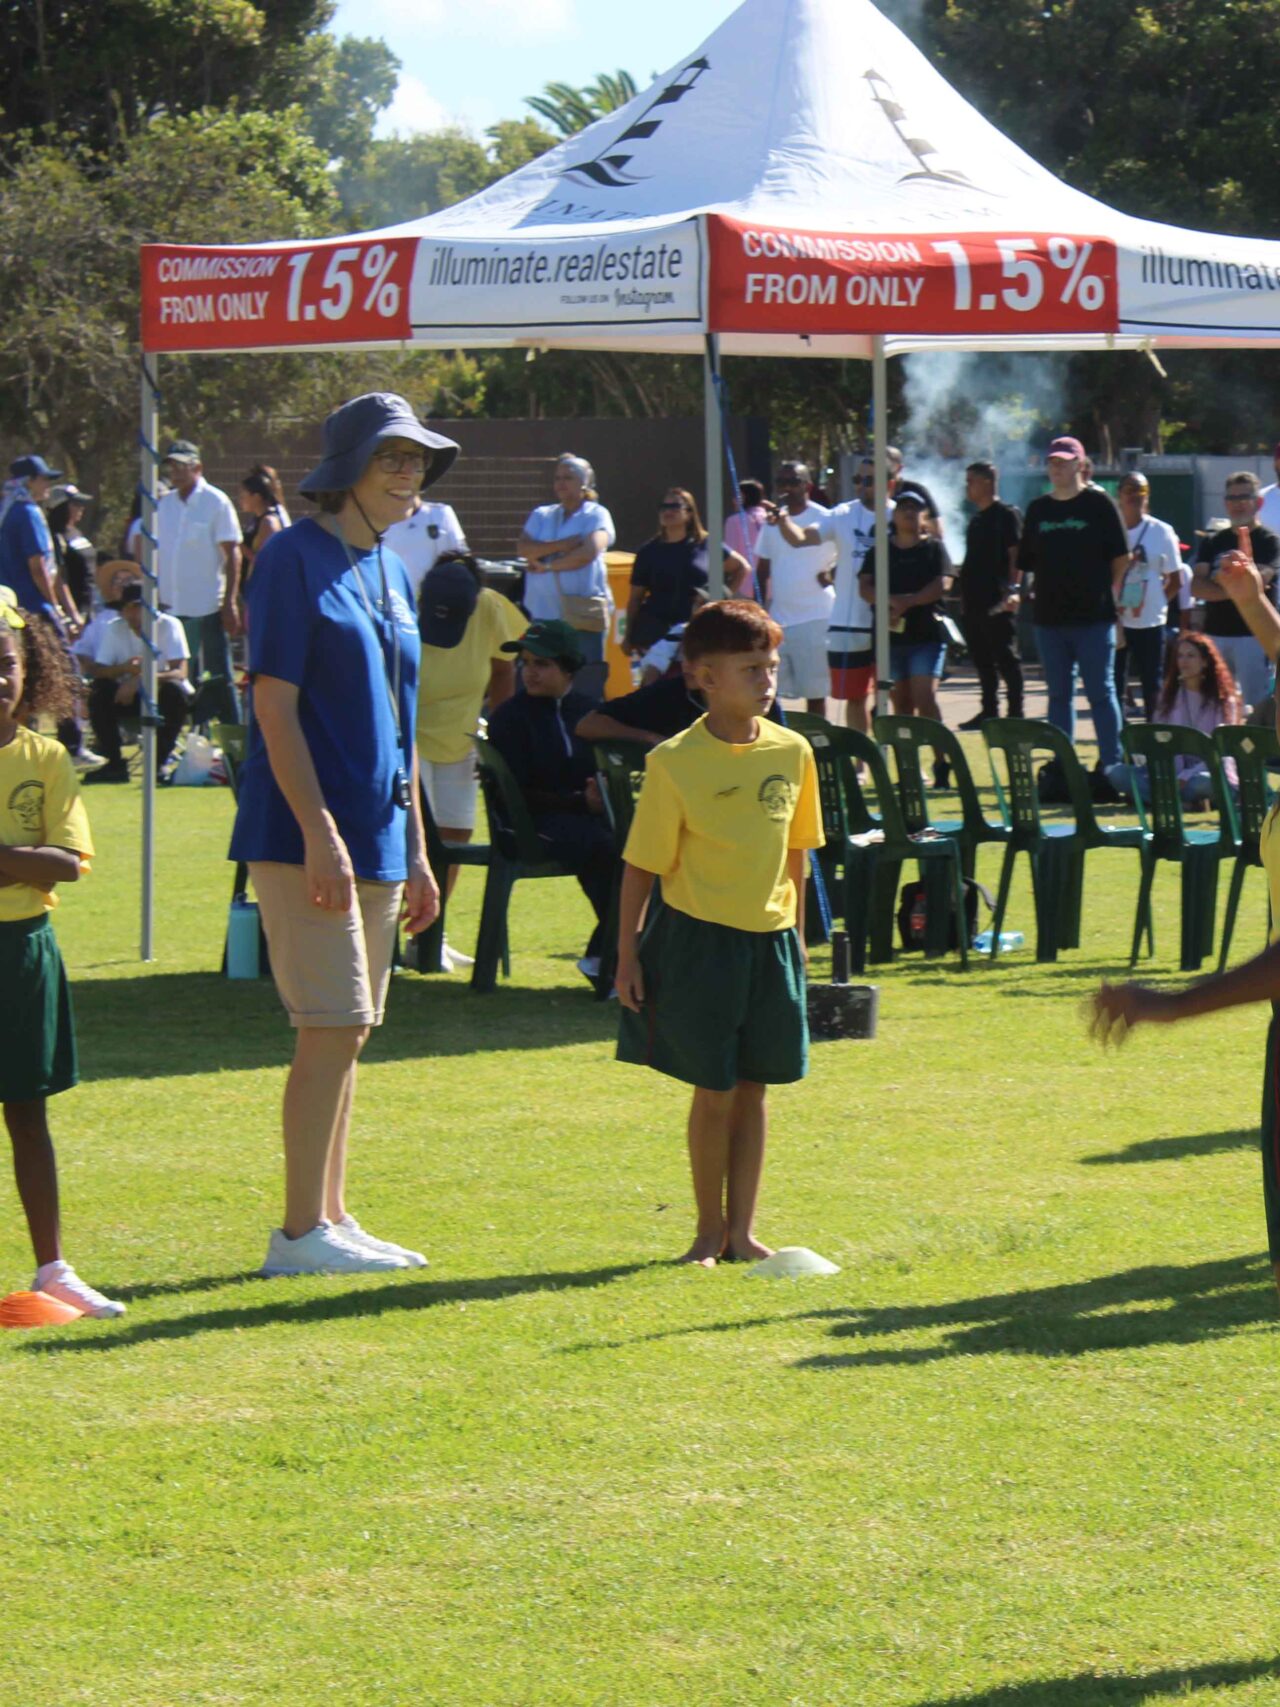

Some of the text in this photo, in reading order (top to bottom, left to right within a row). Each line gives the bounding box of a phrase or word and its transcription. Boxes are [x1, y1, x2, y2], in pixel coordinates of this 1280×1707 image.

[743, 230, 921, 263] COMMISSION
[158, 256, 281, 283] COMMISSION
[429, 244, 682, 286] illuminate.realestate
[930, 237, 1105, 312] 1.5%
[287, 244, 401, 322] 1.5%
[745, 273, 925, 307] FROM ONLY
[160, 291, 269, 324] FROM ONLY
[614, 287, 675, 313] Instagram
